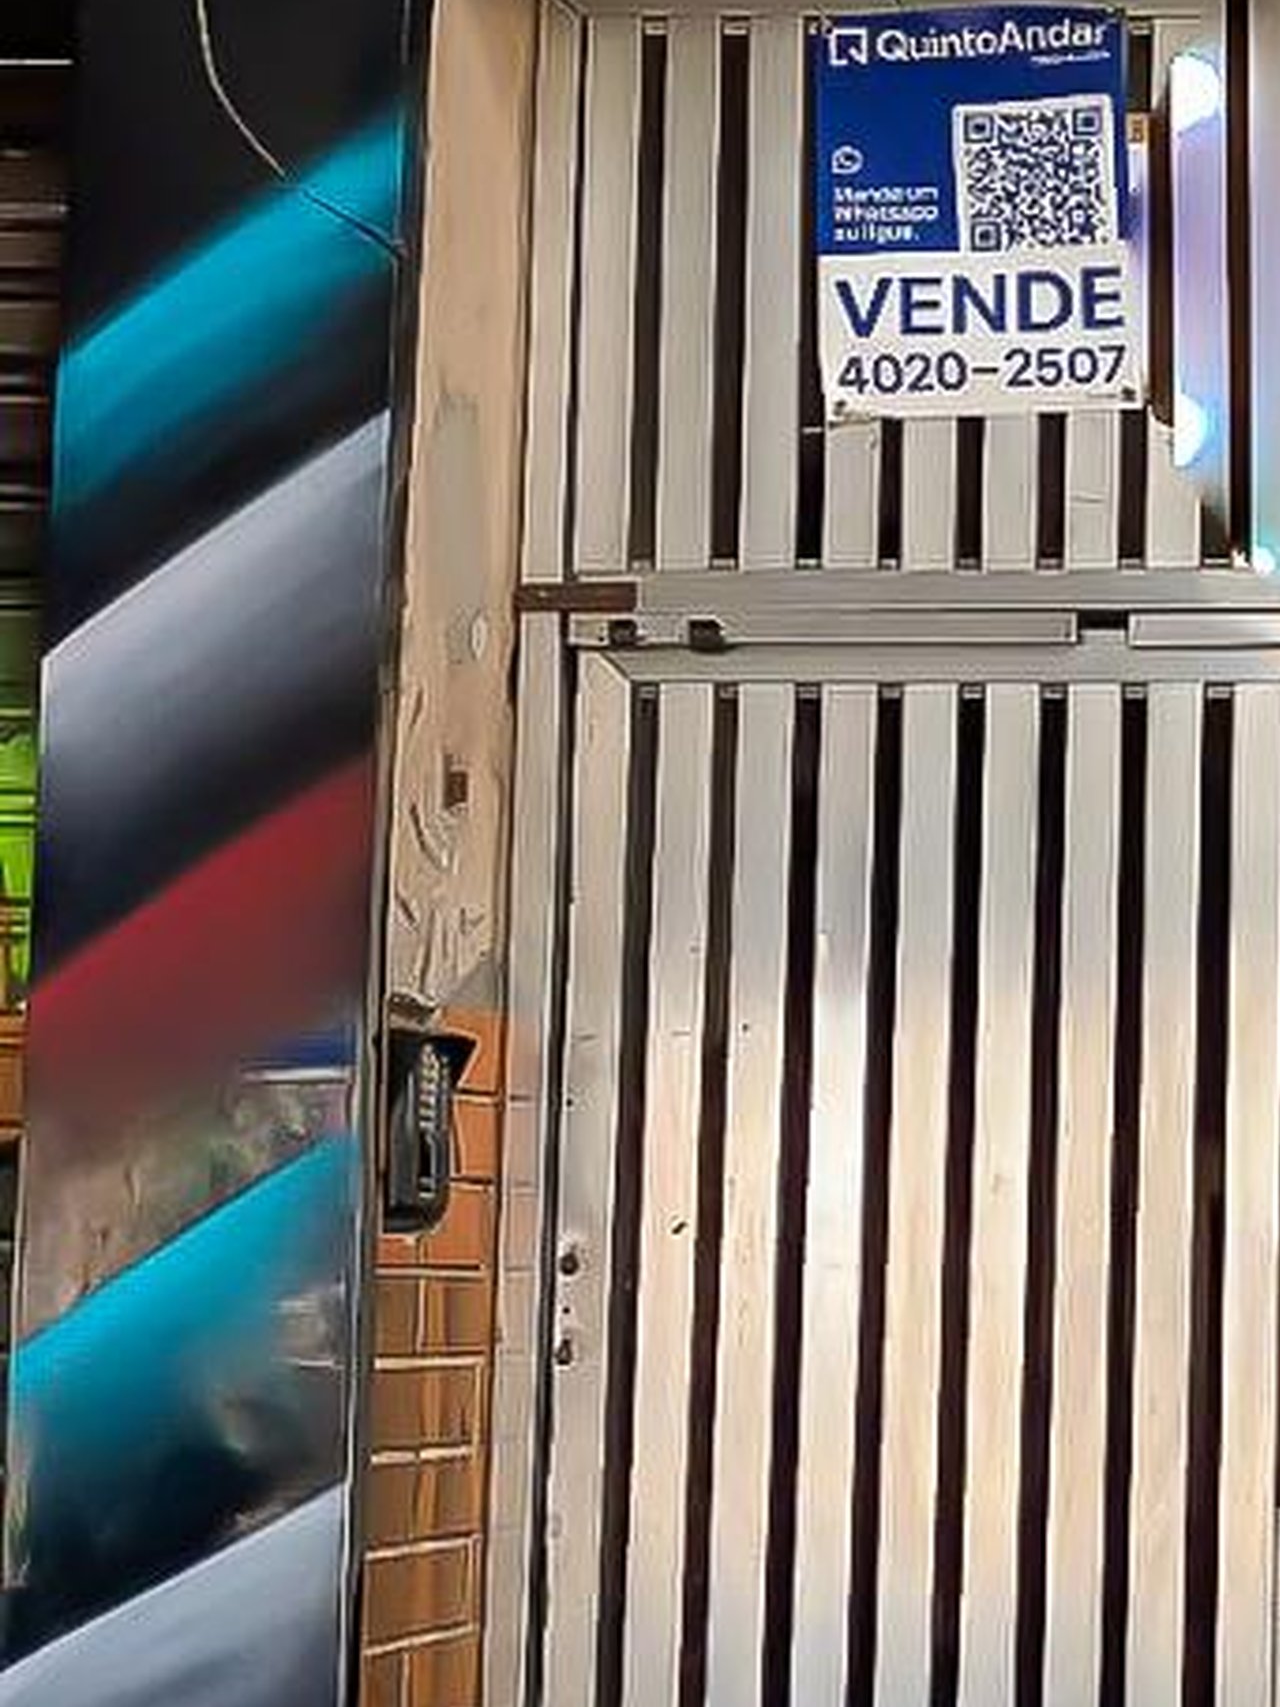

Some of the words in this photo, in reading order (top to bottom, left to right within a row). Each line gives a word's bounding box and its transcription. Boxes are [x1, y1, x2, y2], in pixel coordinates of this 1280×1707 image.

[876, 17, 1108, 62] QuintoAndar
[834, 268, 1126, 339] VENDE
[838, 345, 1127, 394] 4020-2507
